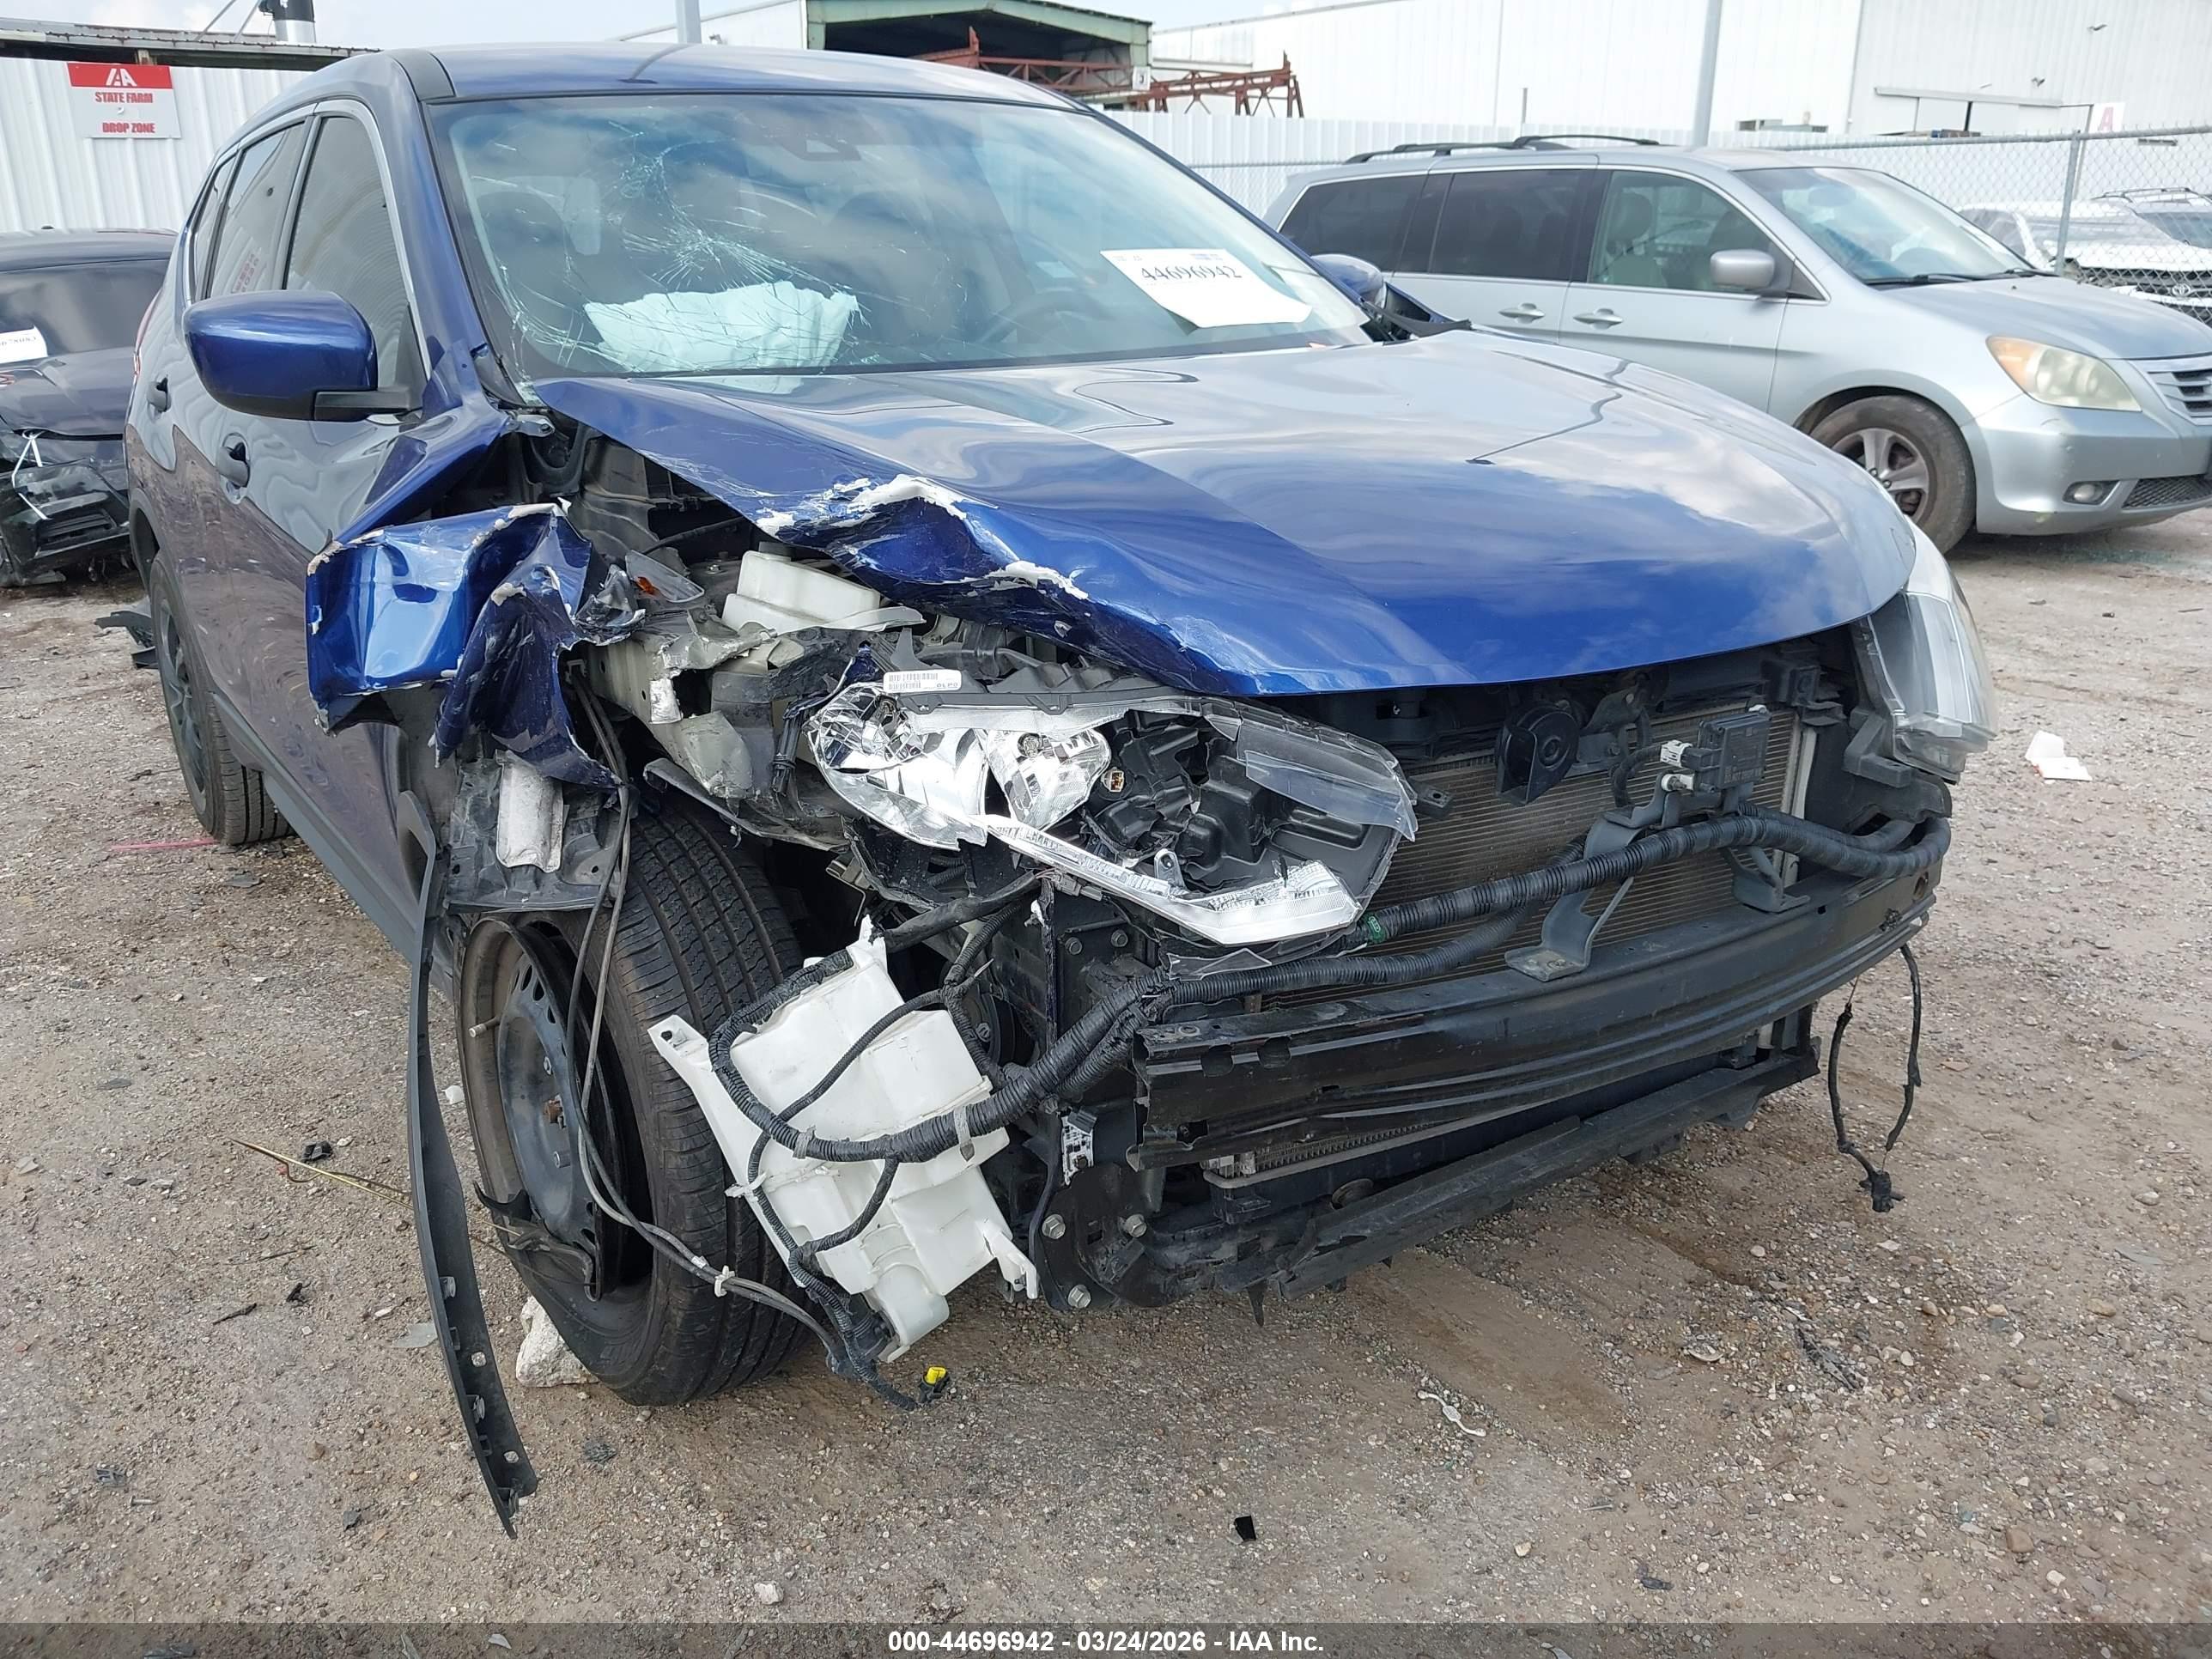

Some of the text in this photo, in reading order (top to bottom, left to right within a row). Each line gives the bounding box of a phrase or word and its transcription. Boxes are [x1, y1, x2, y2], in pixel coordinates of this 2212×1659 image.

[94, 91, 153, 104] STATE FARM
[102, 122, 156, 134] DROP ZONE
[1141, 264, 1243, 281] 44696942
